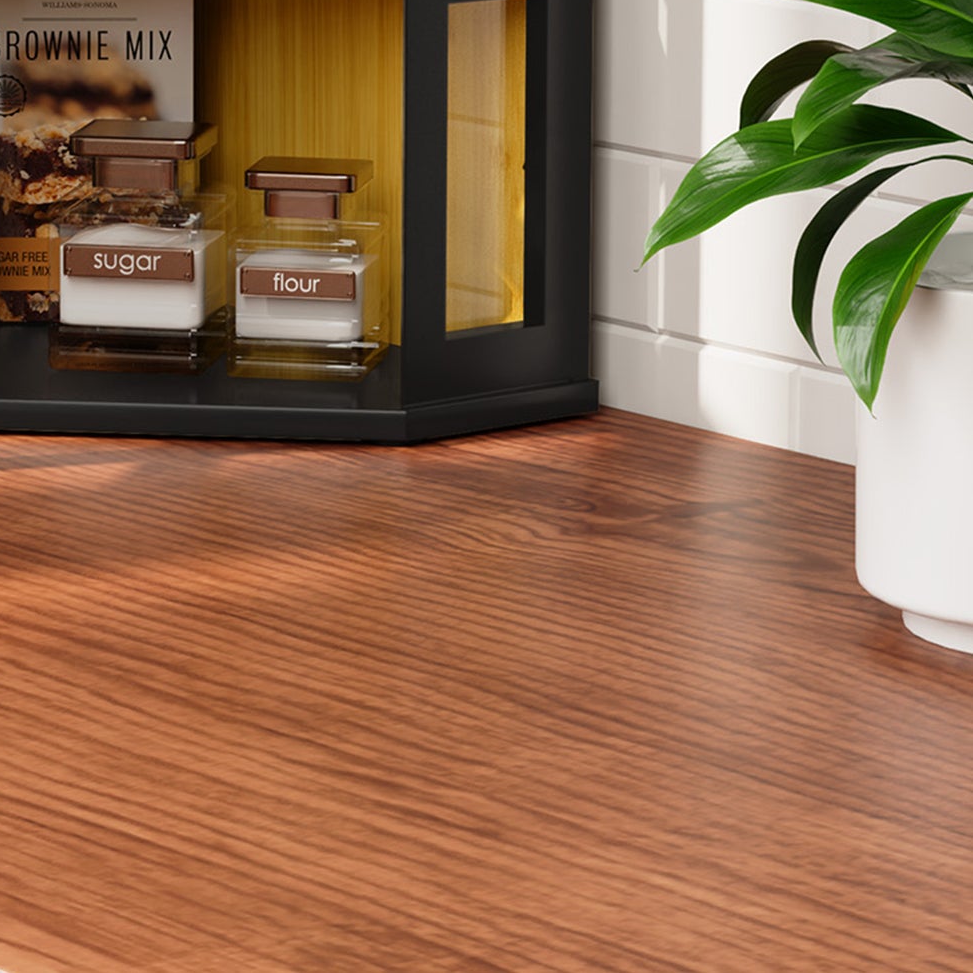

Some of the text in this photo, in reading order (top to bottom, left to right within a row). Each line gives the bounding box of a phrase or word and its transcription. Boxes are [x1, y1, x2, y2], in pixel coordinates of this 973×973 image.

[42, 1, 118, 10] WILLIAMS-SONOMA
[125, 30, 173, 61] MIX
[21, 251, 49, 263] FREE
[93, 251, 163, 275] sugar
[31, 265, 52, 277] MIX
[273, 272, 321, 294] flour
